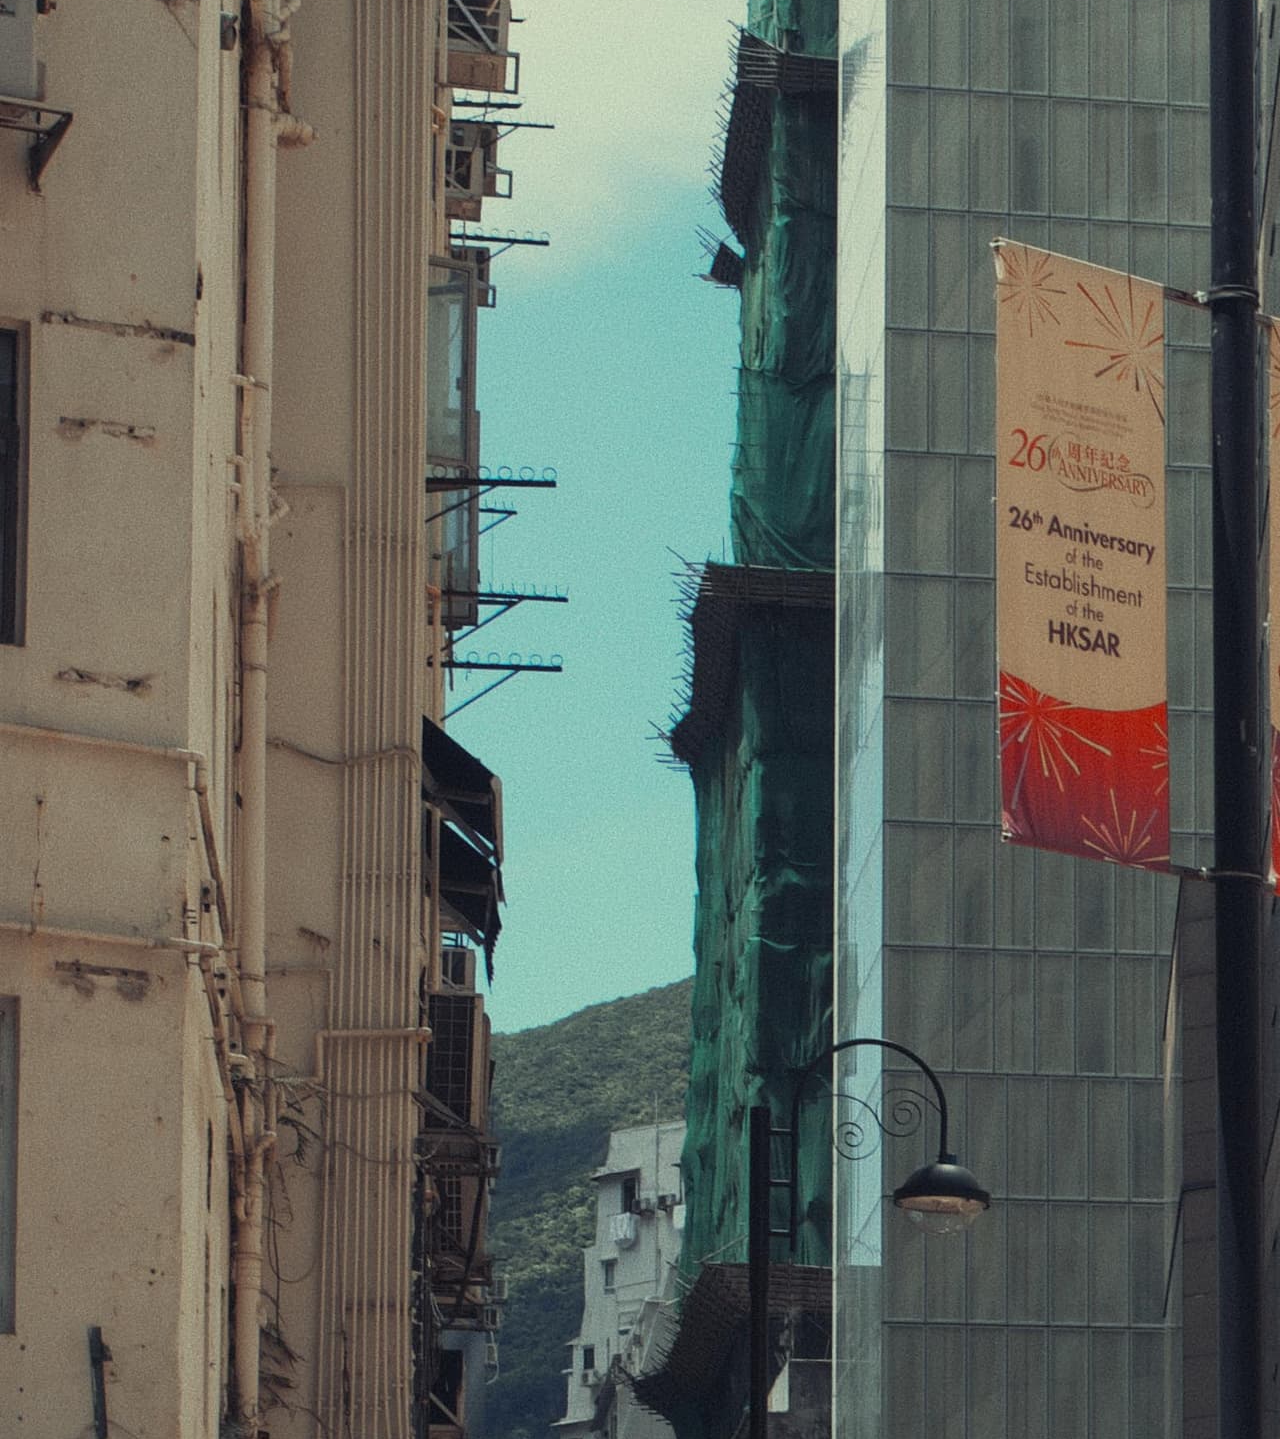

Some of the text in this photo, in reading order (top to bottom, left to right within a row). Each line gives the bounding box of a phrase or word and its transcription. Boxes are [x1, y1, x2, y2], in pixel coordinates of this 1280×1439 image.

[1058, 458, 1150, 498] ANNIVERSARY
[1008, 505, 1156, 565] 26th Anniversary
[1065, 547, 1104, 570] of the
[1024, 561, 1143, 608] Establishment
[1065, 599, 1104, 622] of the
[1048, 618, 1121, 658] HKSAR
